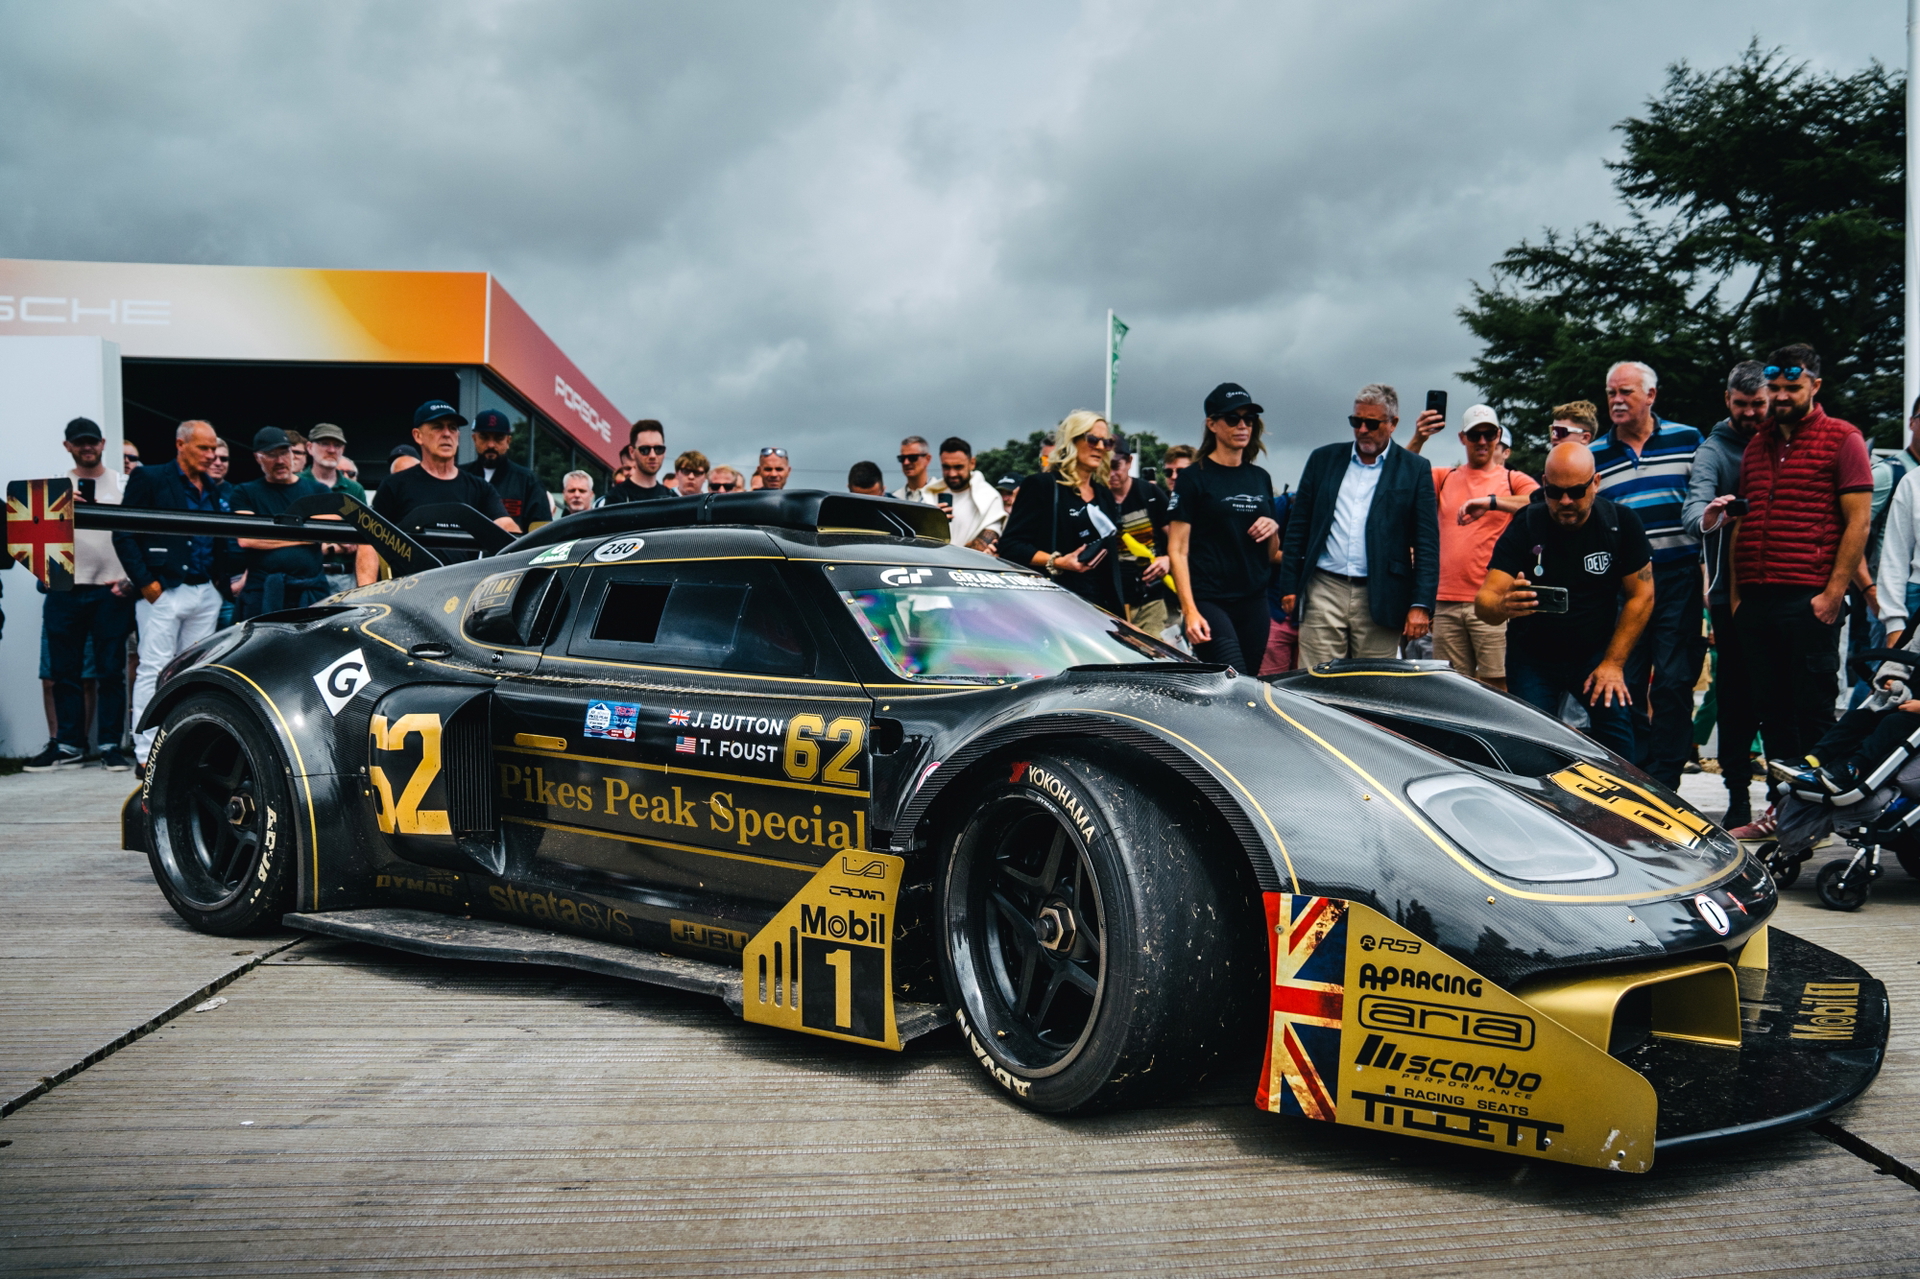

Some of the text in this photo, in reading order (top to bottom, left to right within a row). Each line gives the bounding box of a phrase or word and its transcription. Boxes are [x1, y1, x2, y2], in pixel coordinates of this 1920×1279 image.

[555, 374, 611, 444] PORSCHE
[357, 509, 412, 562] YOKOHAMA
[600, 542, 638, 555] 280
[948, 571, 1006, 585] GRAN
[1587, 555, 1609, 571] DEUS
[327, 662, 363, 698] G
[691, 712, 784, 736] J. BUTTON
[142, 730, 168, 800] YOKOHAMA
[700, 739, 778, 763] T. FOUST
[782, 712, 866, 788] 62
[497, 762, 868, 851] Pikes Peak Special
[1028, 765, 1095, 844] YOKOHAMA
[1548, 762, 1714, 850] 62
[376, 875, 453, 896] DYMAG
[801, 903, 885, 945] Mobil
[1698, 901, 1726, 930] T
[1378, 937, 1422, 955] R53
[825, 949, 851, 1029] 1
[1369, 1003, 1522, 1043] aria
[1788, 998, 1858, 1040] Mobil
[956, 1008, 1032, 1098] ADVAN
[1401, 1073, 1533, 1100] PERFORMANCE
[1404, 1055, 1542, 1093] scarbo
[1403, 1087, 1529, 1116] RACING SEATS
